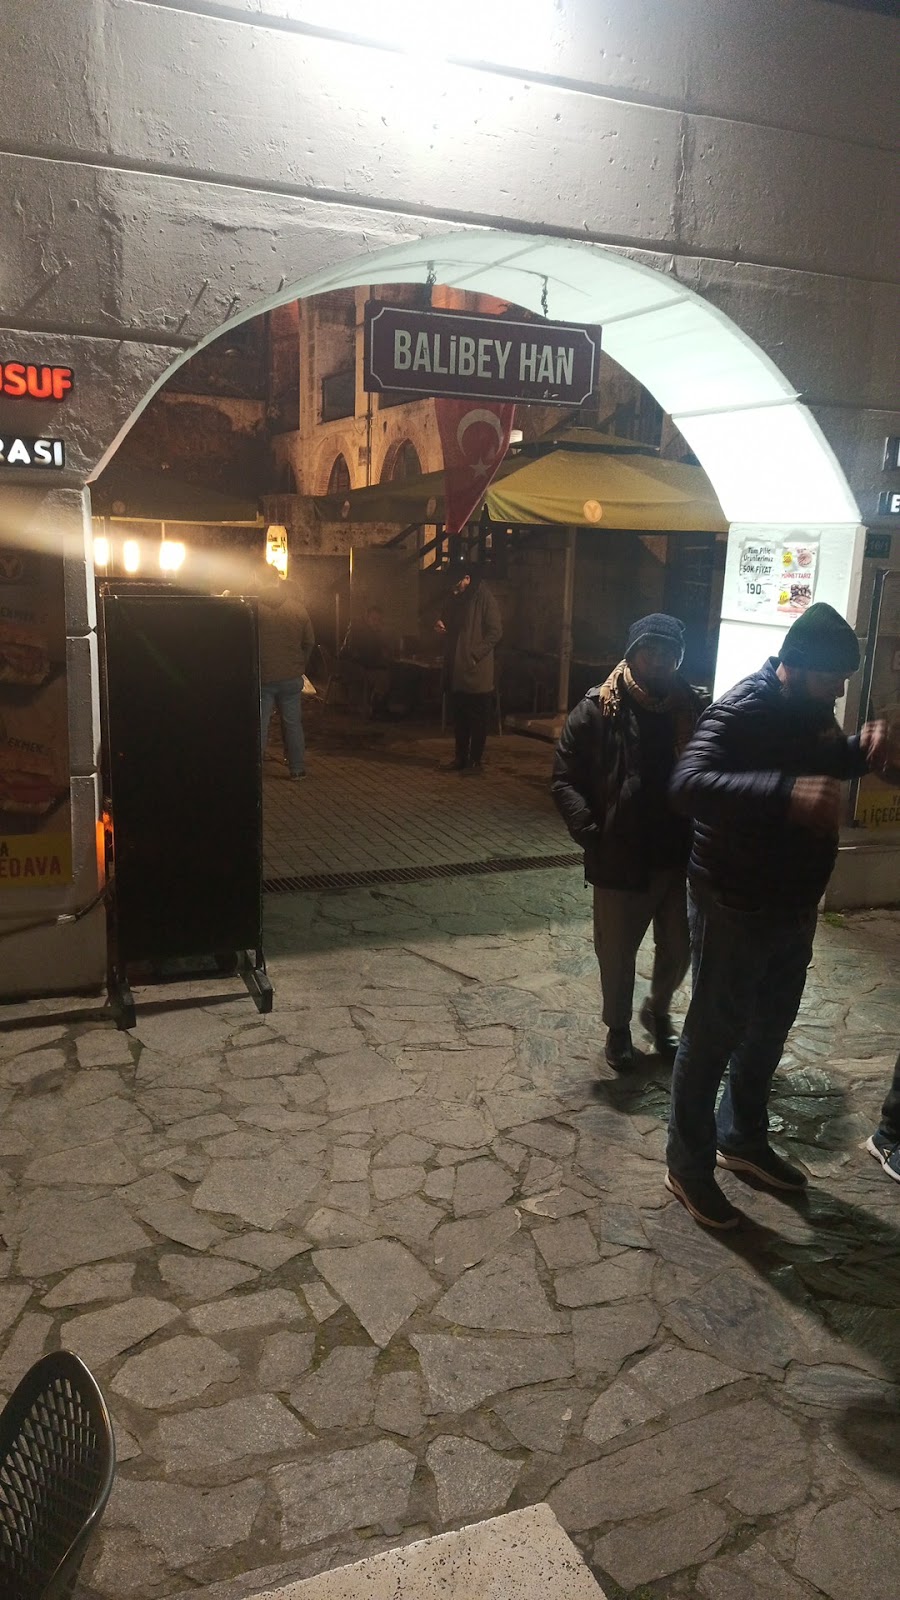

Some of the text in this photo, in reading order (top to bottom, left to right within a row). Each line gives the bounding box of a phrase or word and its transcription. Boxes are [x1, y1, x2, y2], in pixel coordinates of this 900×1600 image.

[0, 363, 72, 399] SUF
[519, 342, 575, 385] HAN
[746, 582, 762, 595] 190
